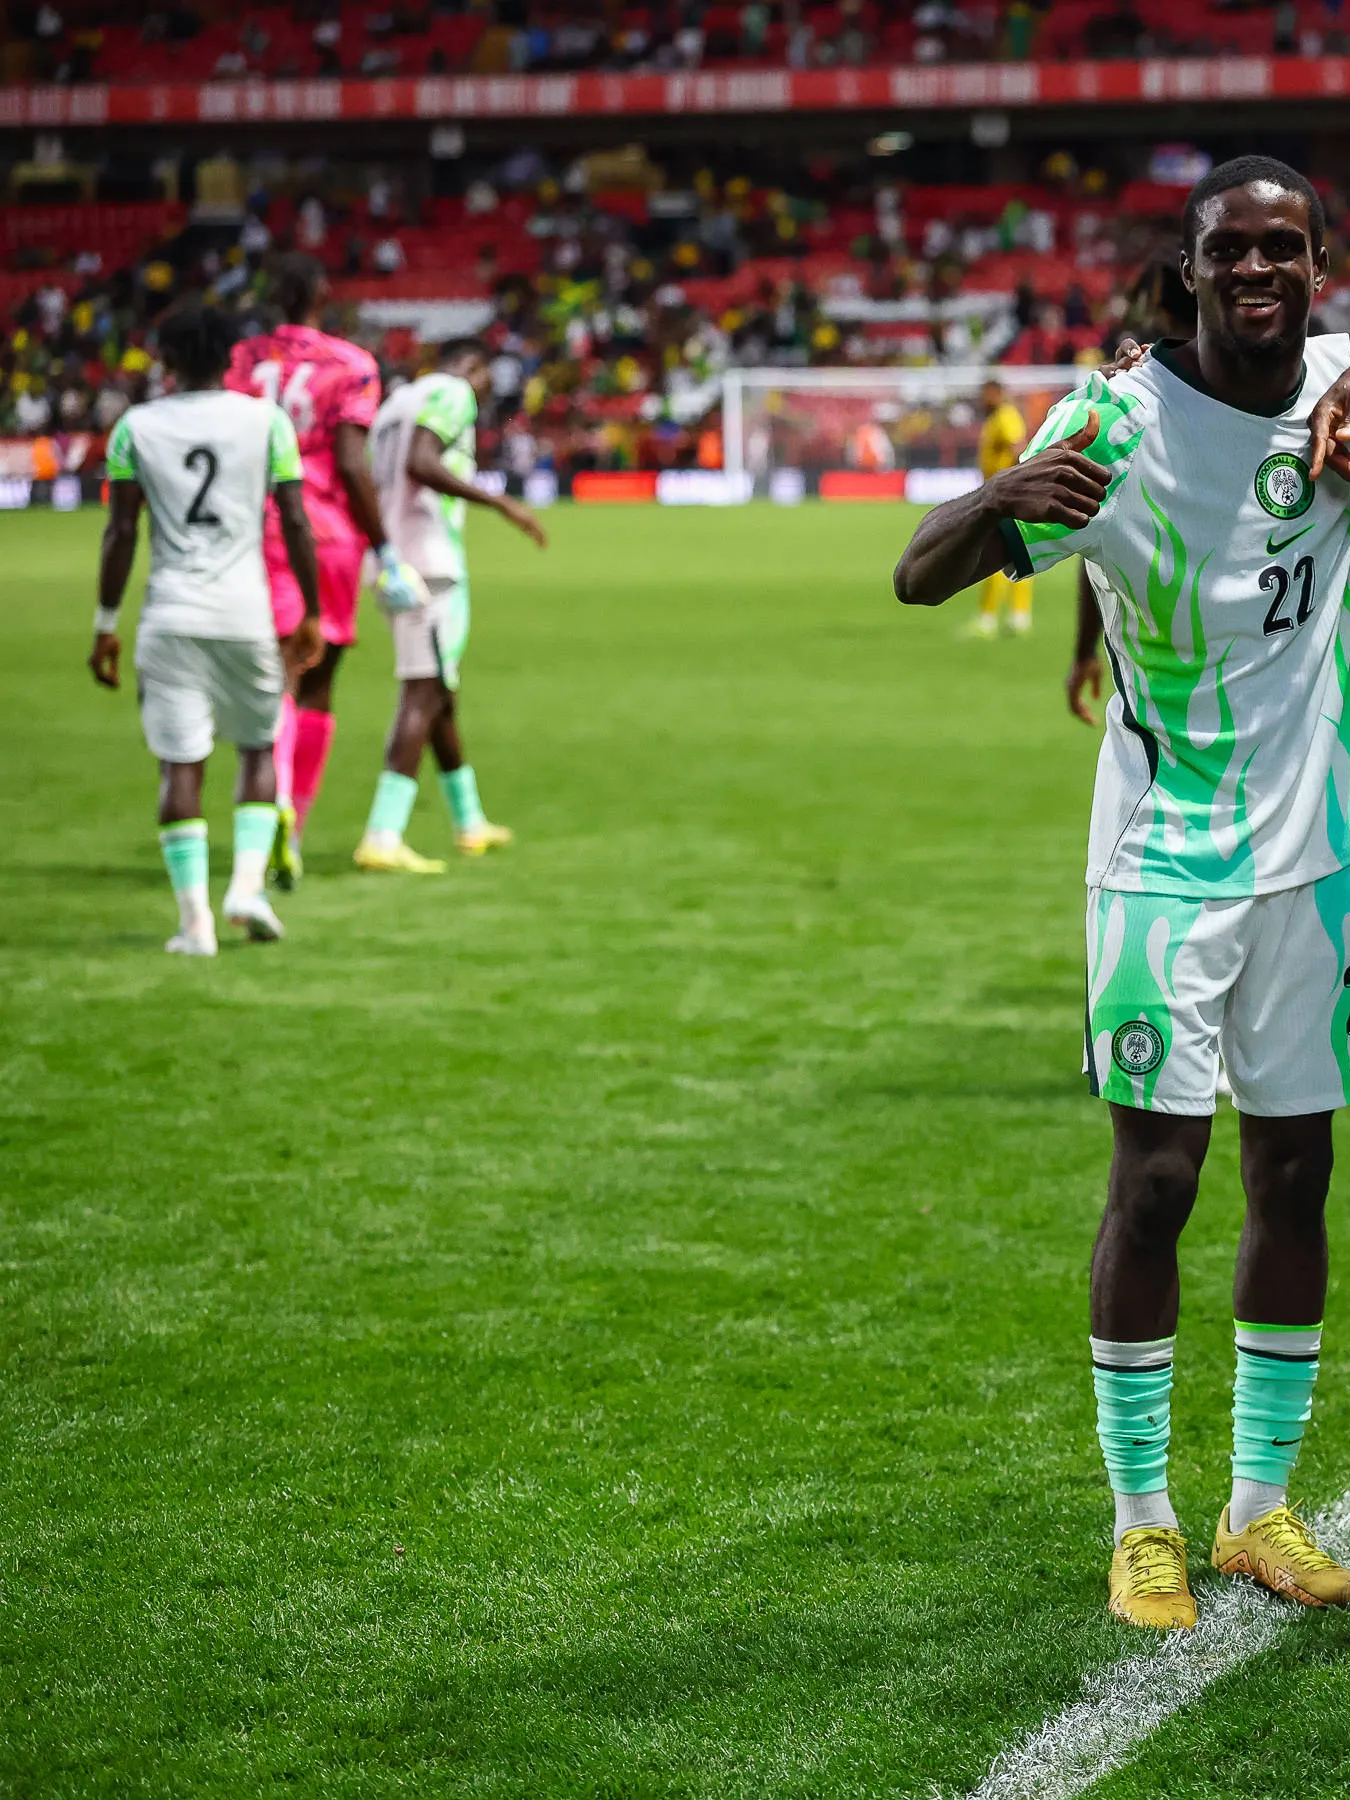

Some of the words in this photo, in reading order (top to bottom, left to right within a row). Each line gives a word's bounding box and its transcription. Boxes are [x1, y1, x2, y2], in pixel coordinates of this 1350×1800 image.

[251, 359, 315, 432] 16
[184, 446, 221, 526] 2
[1260, 457, 1290, 480] FOOTBALL
